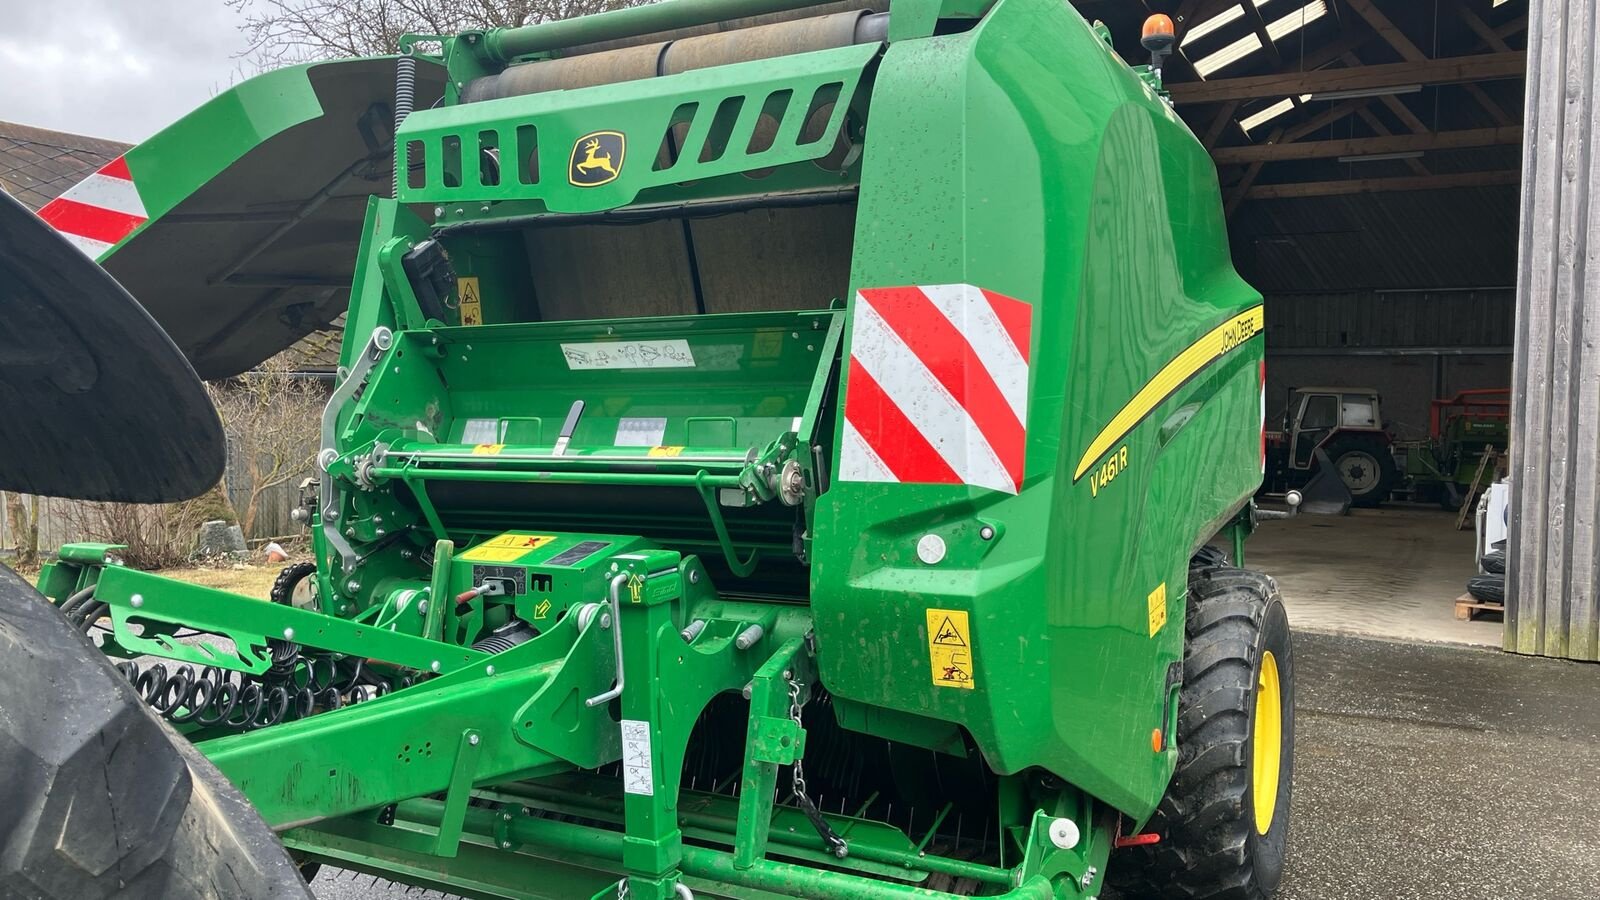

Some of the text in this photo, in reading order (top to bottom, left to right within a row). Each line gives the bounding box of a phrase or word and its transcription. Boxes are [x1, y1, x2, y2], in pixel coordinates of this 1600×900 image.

[1221, 317, 1254, 352] JOHN DEERE
[1090, 445, 1128, 498] V 461 R
